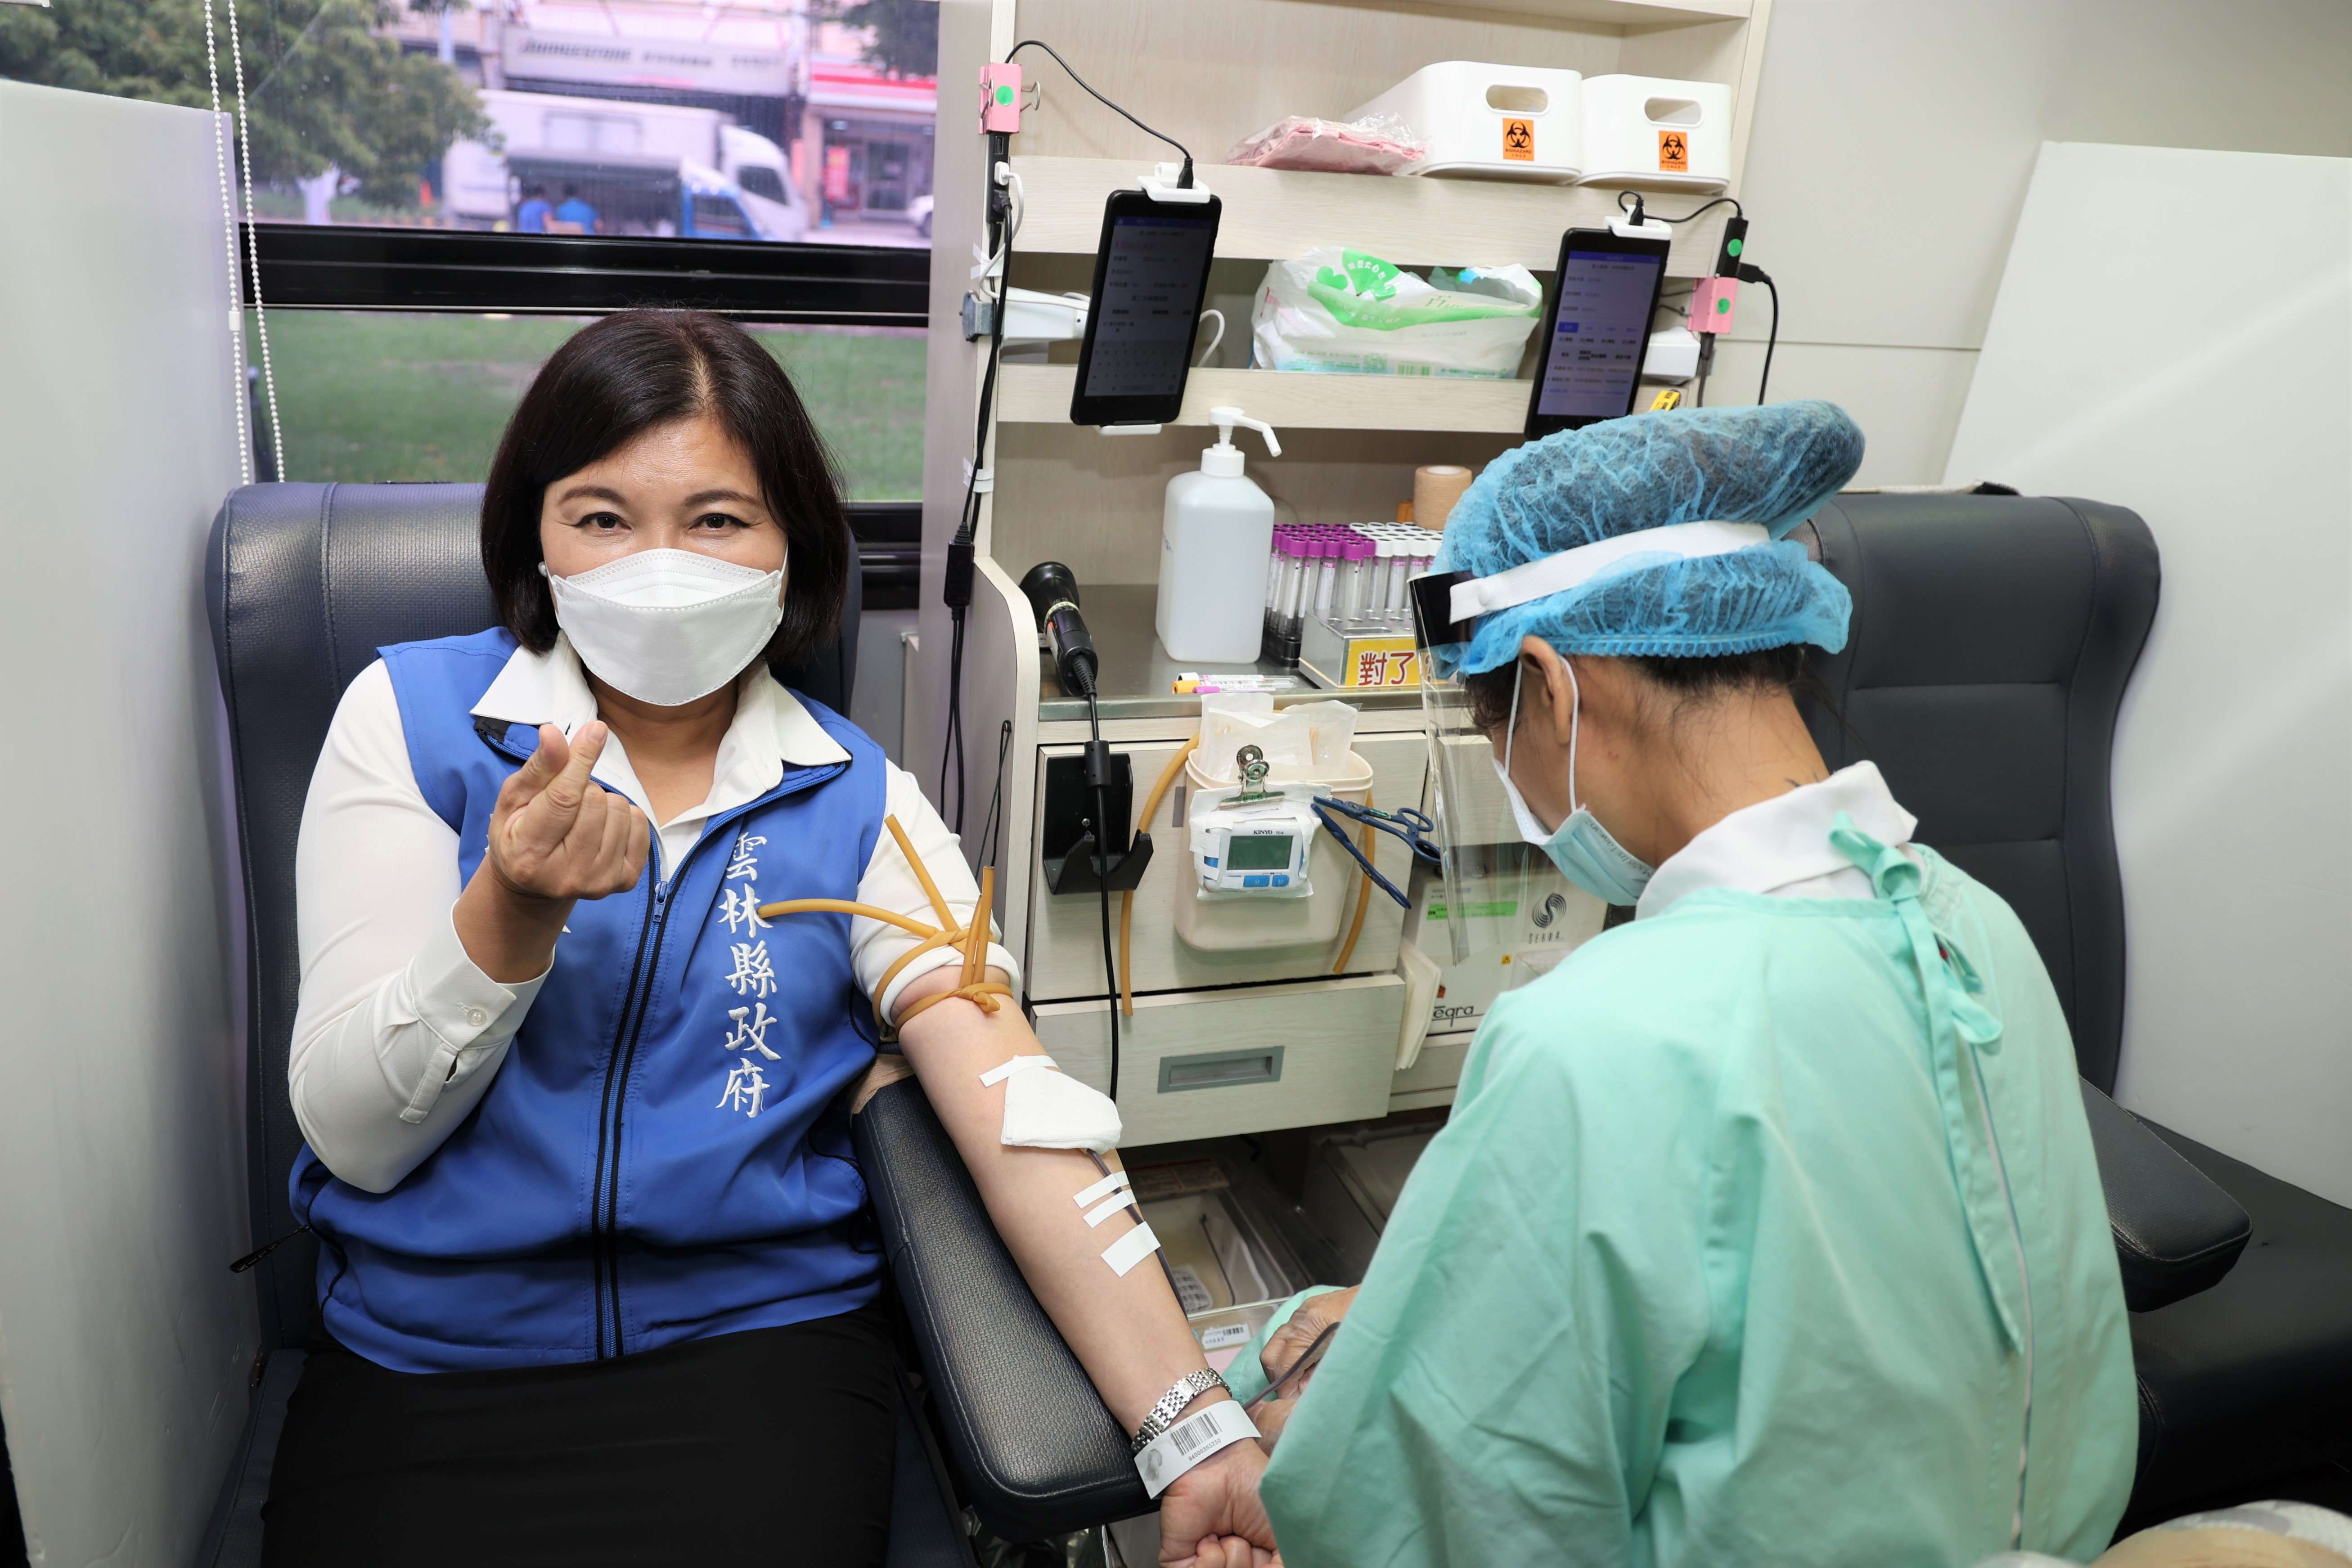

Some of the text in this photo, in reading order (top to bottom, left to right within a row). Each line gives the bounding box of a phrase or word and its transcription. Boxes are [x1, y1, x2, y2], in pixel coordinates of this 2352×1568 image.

[715, 831, 782, 1119] 雲林縣政府
